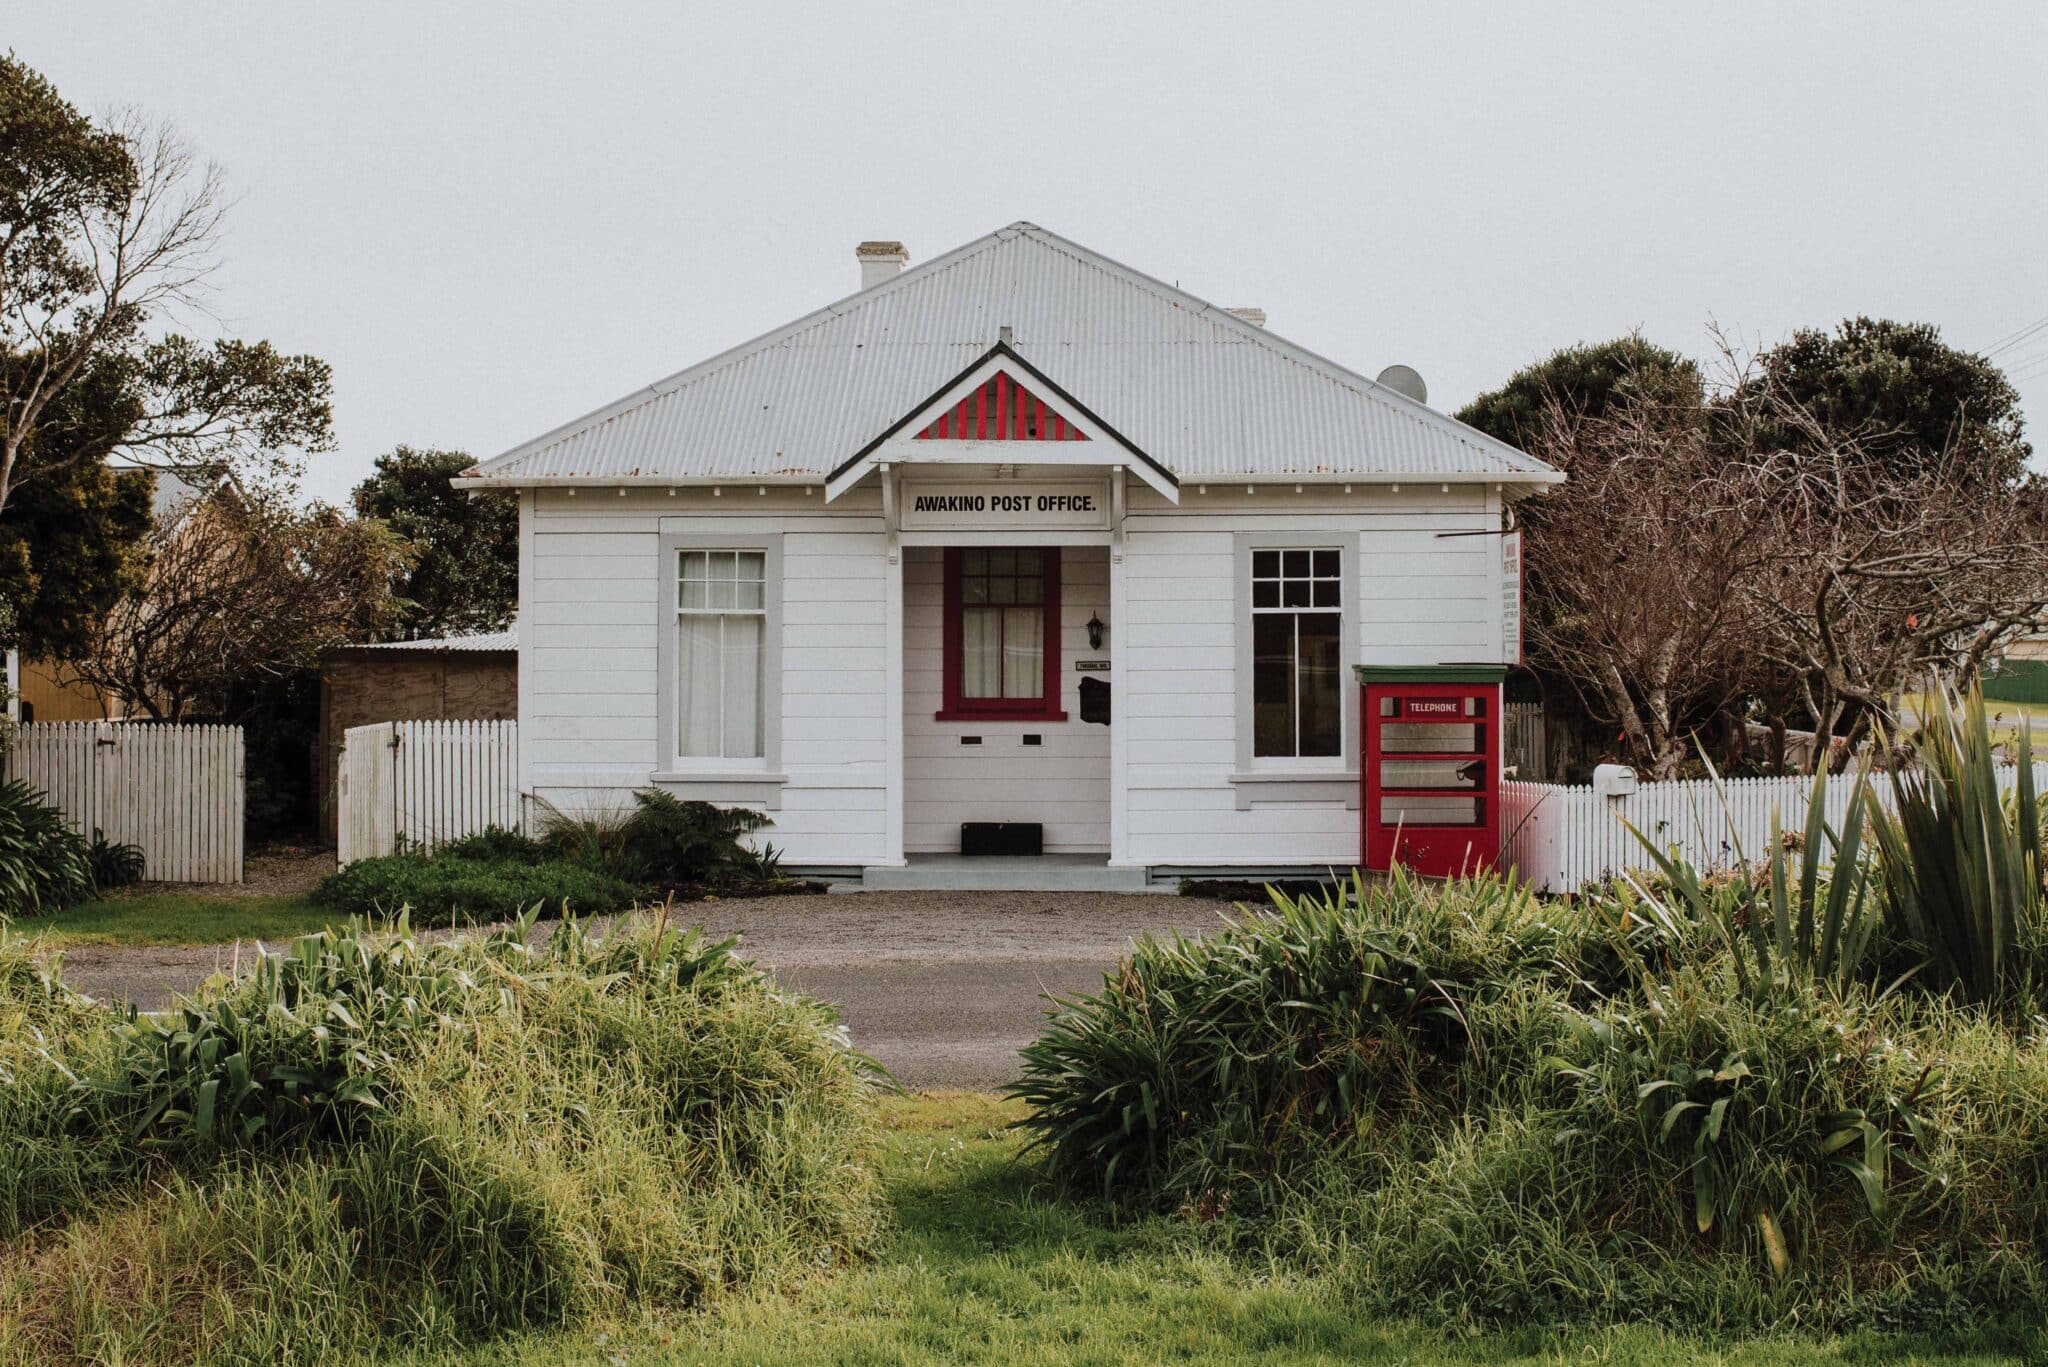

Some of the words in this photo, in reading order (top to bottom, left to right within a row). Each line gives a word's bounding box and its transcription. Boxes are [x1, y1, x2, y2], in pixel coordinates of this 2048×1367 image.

[914, 495, 985, 512] AWAKINO
[991, 495, 1032, 512] POST
[1037, 495, 1097, 512] OFFICE.
[1410, 703, 1457, 712] TELEPHONE
